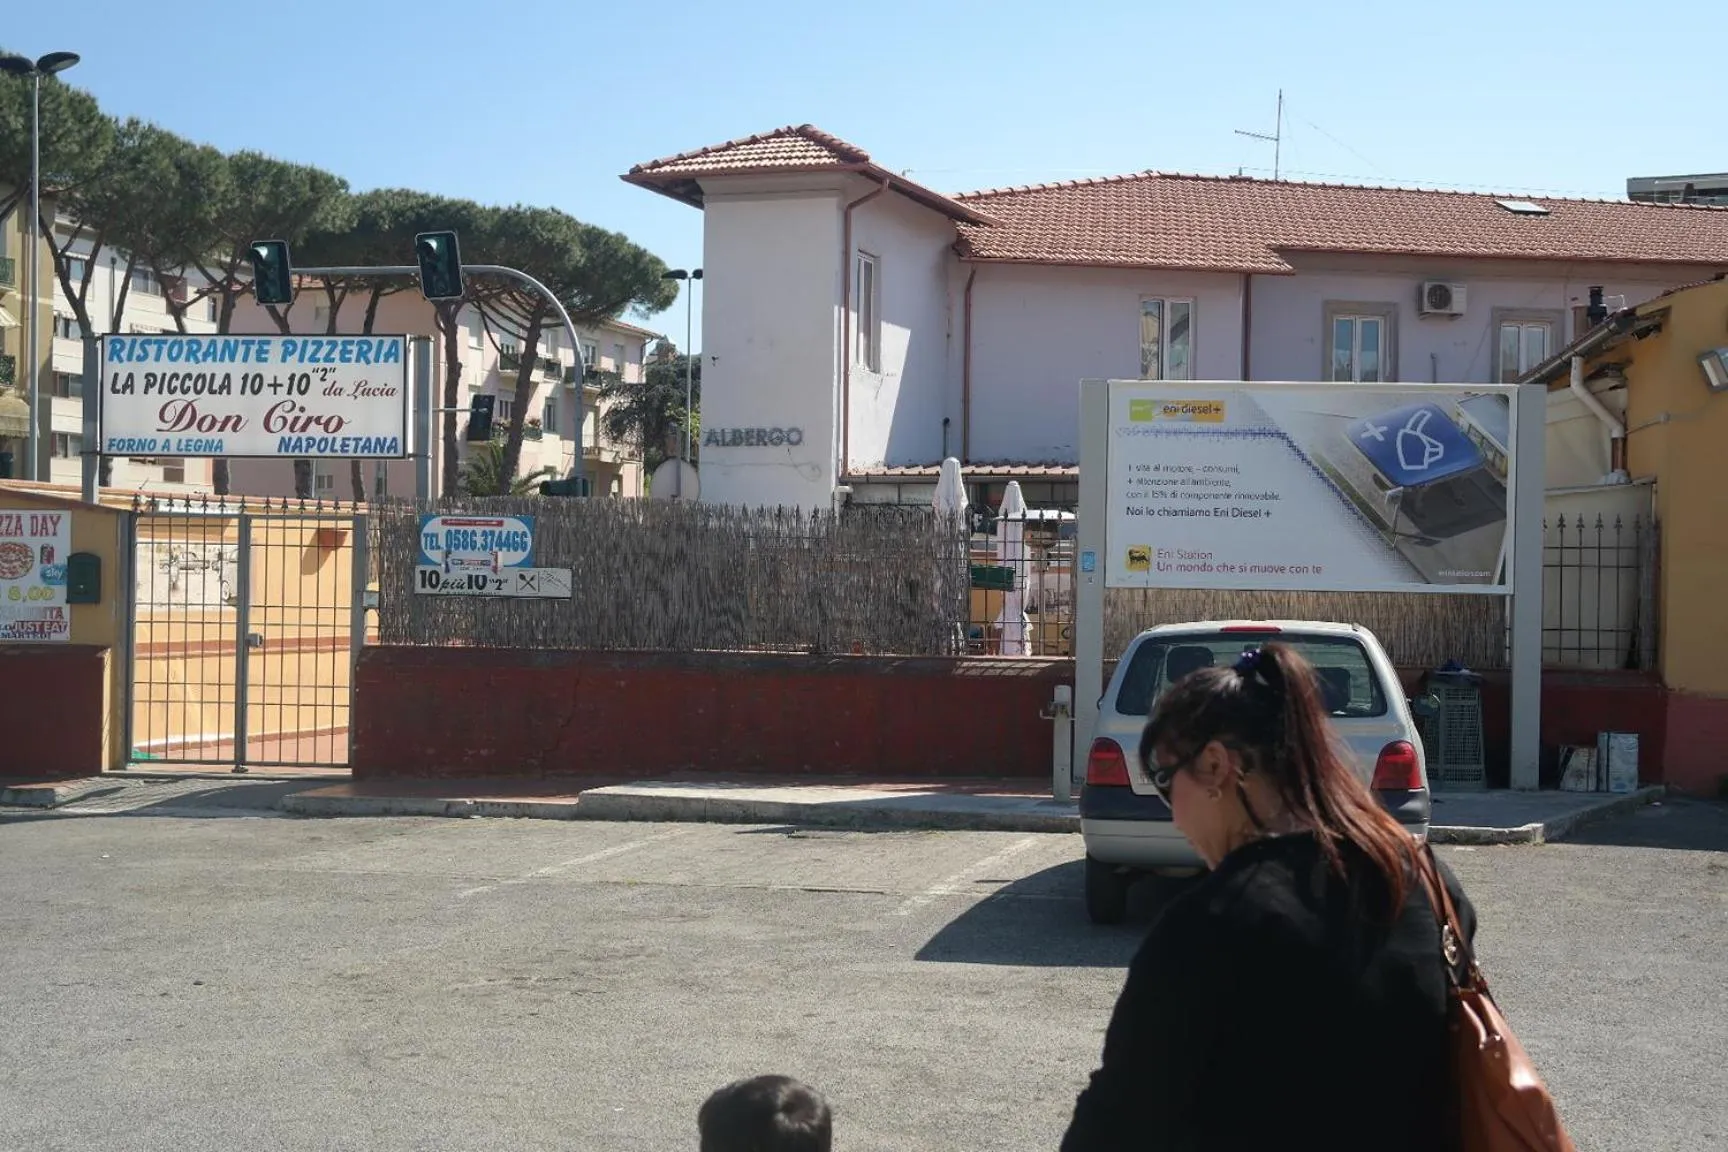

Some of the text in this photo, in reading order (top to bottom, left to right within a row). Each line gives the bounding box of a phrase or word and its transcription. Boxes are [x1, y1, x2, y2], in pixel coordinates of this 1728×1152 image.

[108, 338, 400, 364] RISTORANTE PIZZERIA
[110, 373, 135, 395] LA
[143, 373, 232, 395] PICCOLA
[240, 372, 311, 396] 10+10
[322, 379, 398, 400] da Lucia
[156, 399, 351, 434] Don Ciro
[107, 436, 399, 454] FORNO A LEGNA NAPOLETANA
[703, 427, 803, 447] ALBERGO
[1126, 506, 1144, 516] Noi
[1145, 506, 1155, 516] lo
[1157, 506, 1211, 517] chiamiamo
[1213, 507, 1229, 517] Eni
[1231, 507, 1262, 518] Diesel
[30, 514, 62, 537] DAY
[445, 529, 529, 552] 0586.374466
[1177, 549, 1213, 560] Station
[1156, 561, 1323, 574] Un mondo che si muove con te
[420, 570, 440, 589] 10
[467, 574, 488, 590] 10
[12, 621, 42, 632] JUST
